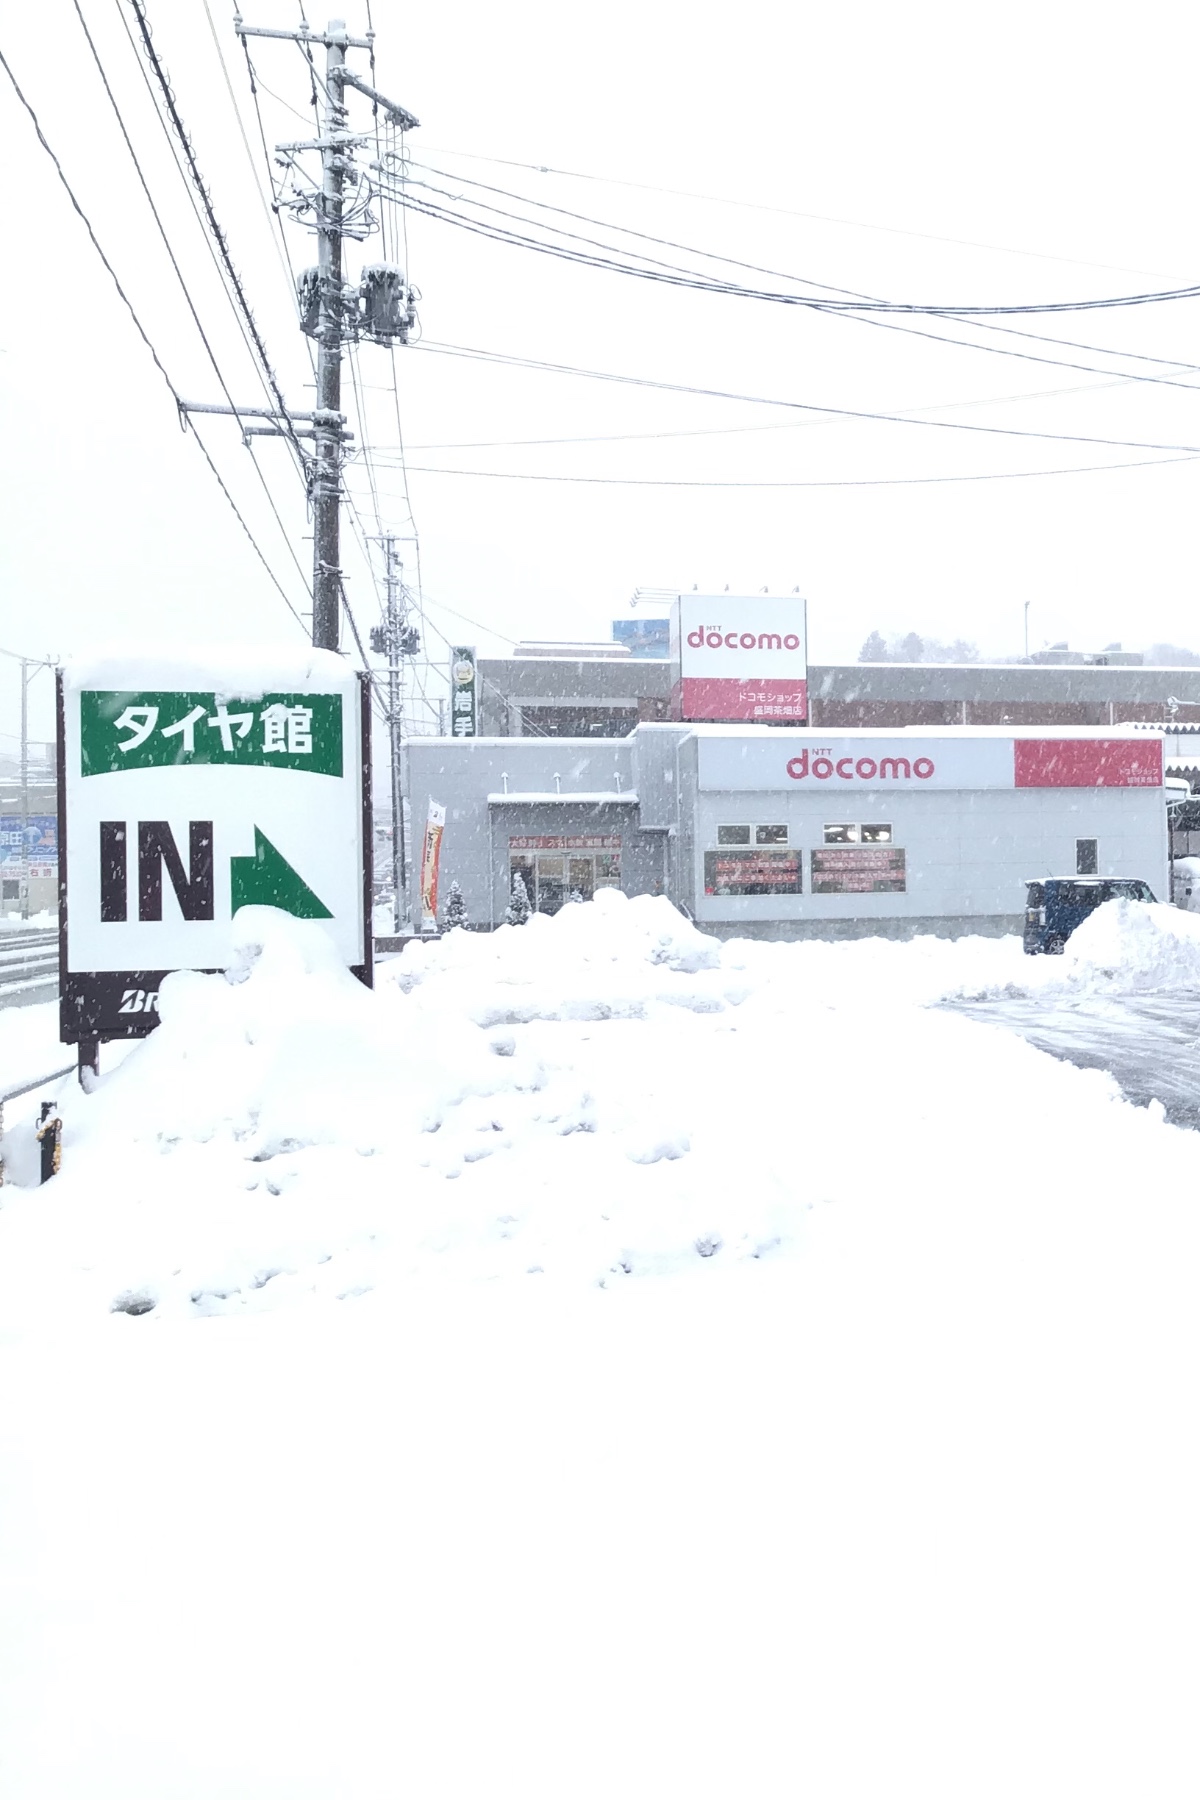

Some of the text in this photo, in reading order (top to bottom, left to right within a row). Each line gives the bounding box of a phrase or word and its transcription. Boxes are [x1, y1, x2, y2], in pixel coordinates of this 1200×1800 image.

[687, 625, 800, 650] docomo
[739, 692, 803, 703] ドコモショップ
[113, 703, 314, 754] タイヤ館
[786, 748, 935, 779] docomo
[812, 748, 833, 756] NTT
[100, 820, 214, 923] IN
